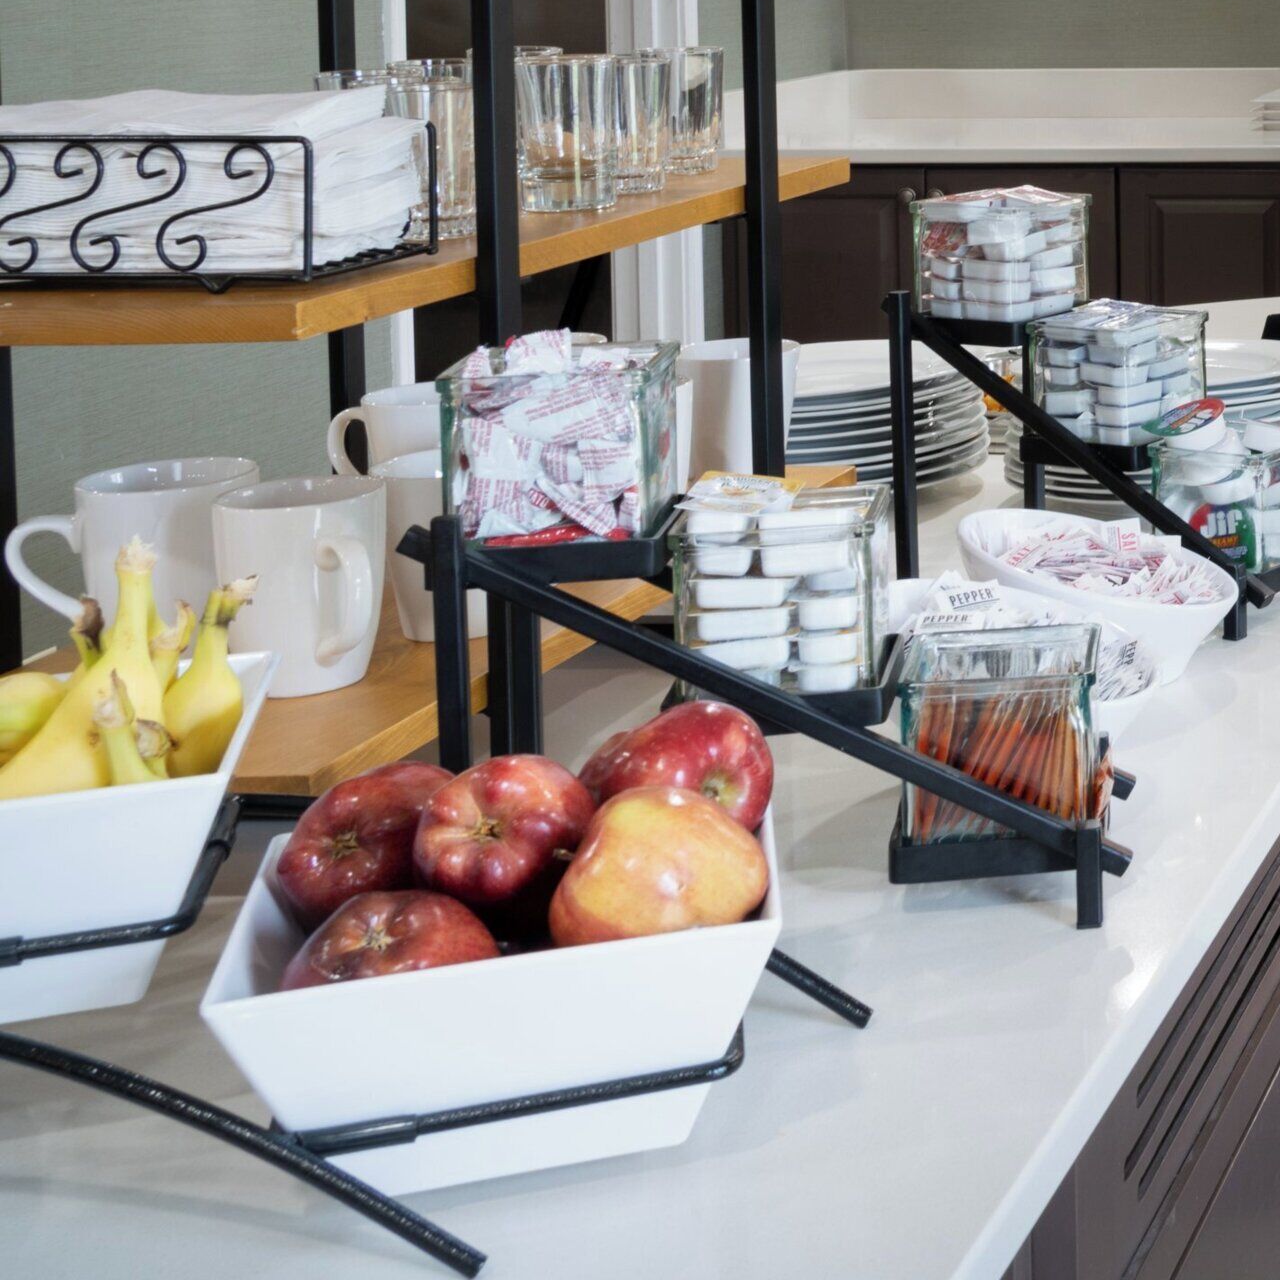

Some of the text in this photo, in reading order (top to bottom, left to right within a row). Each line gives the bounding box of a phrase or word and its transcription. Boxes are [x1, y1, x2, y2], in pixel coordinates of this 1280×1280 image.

[1200, 509, 1243, 539] Jif
[948, 587, 994, 607] PEPPER
[923, 614, 969, 624] PEPPER
[1124, 640, 1138, 665] PEPP
